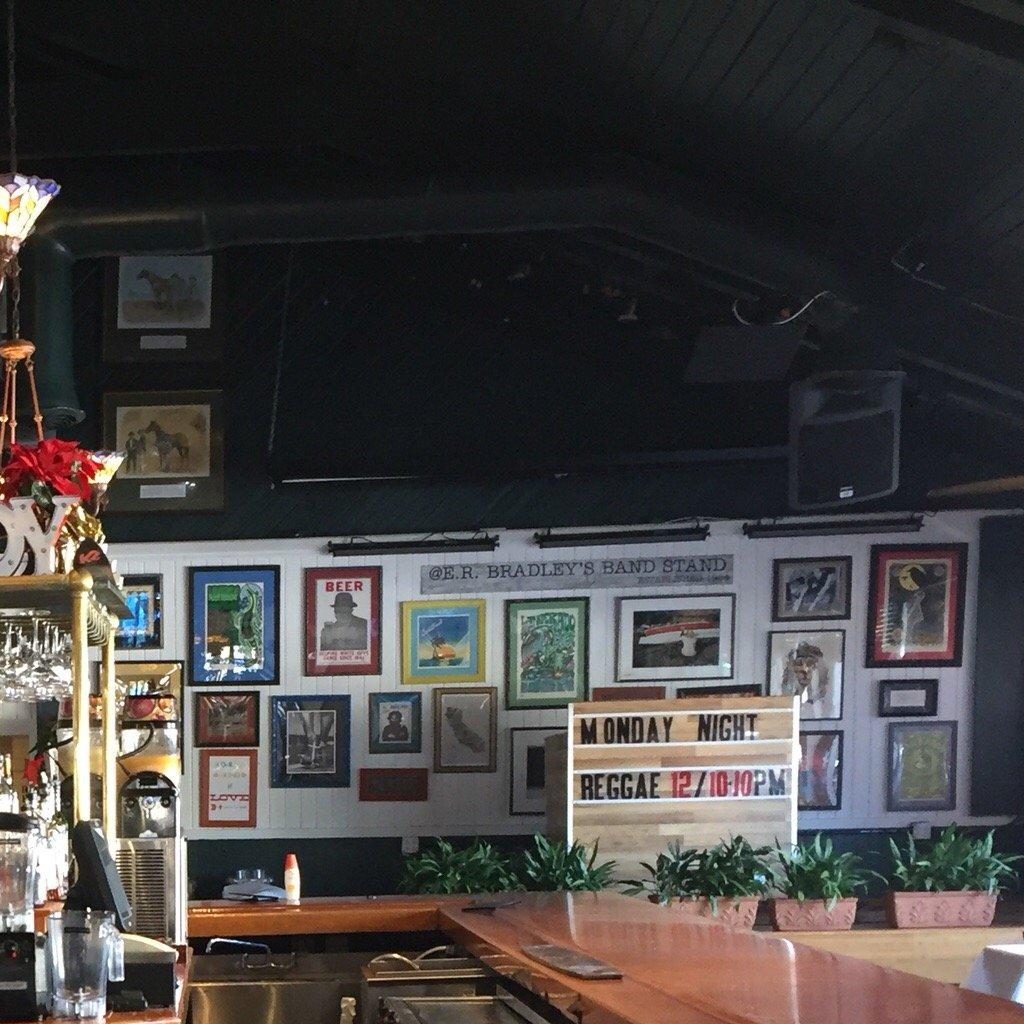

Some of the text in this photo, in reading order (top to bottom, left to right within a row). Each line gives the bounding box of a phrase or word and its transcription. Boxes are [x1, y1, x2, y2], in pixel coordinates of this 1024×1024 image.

[429, 557, 727, 580] @E.R. BRADLEY'S BAND STAND
[325, 581, 364, 592] BEER
[580, 714, 758, 744] MONDAY NIGHT
[581, 772, 661, 800] REGGAE
